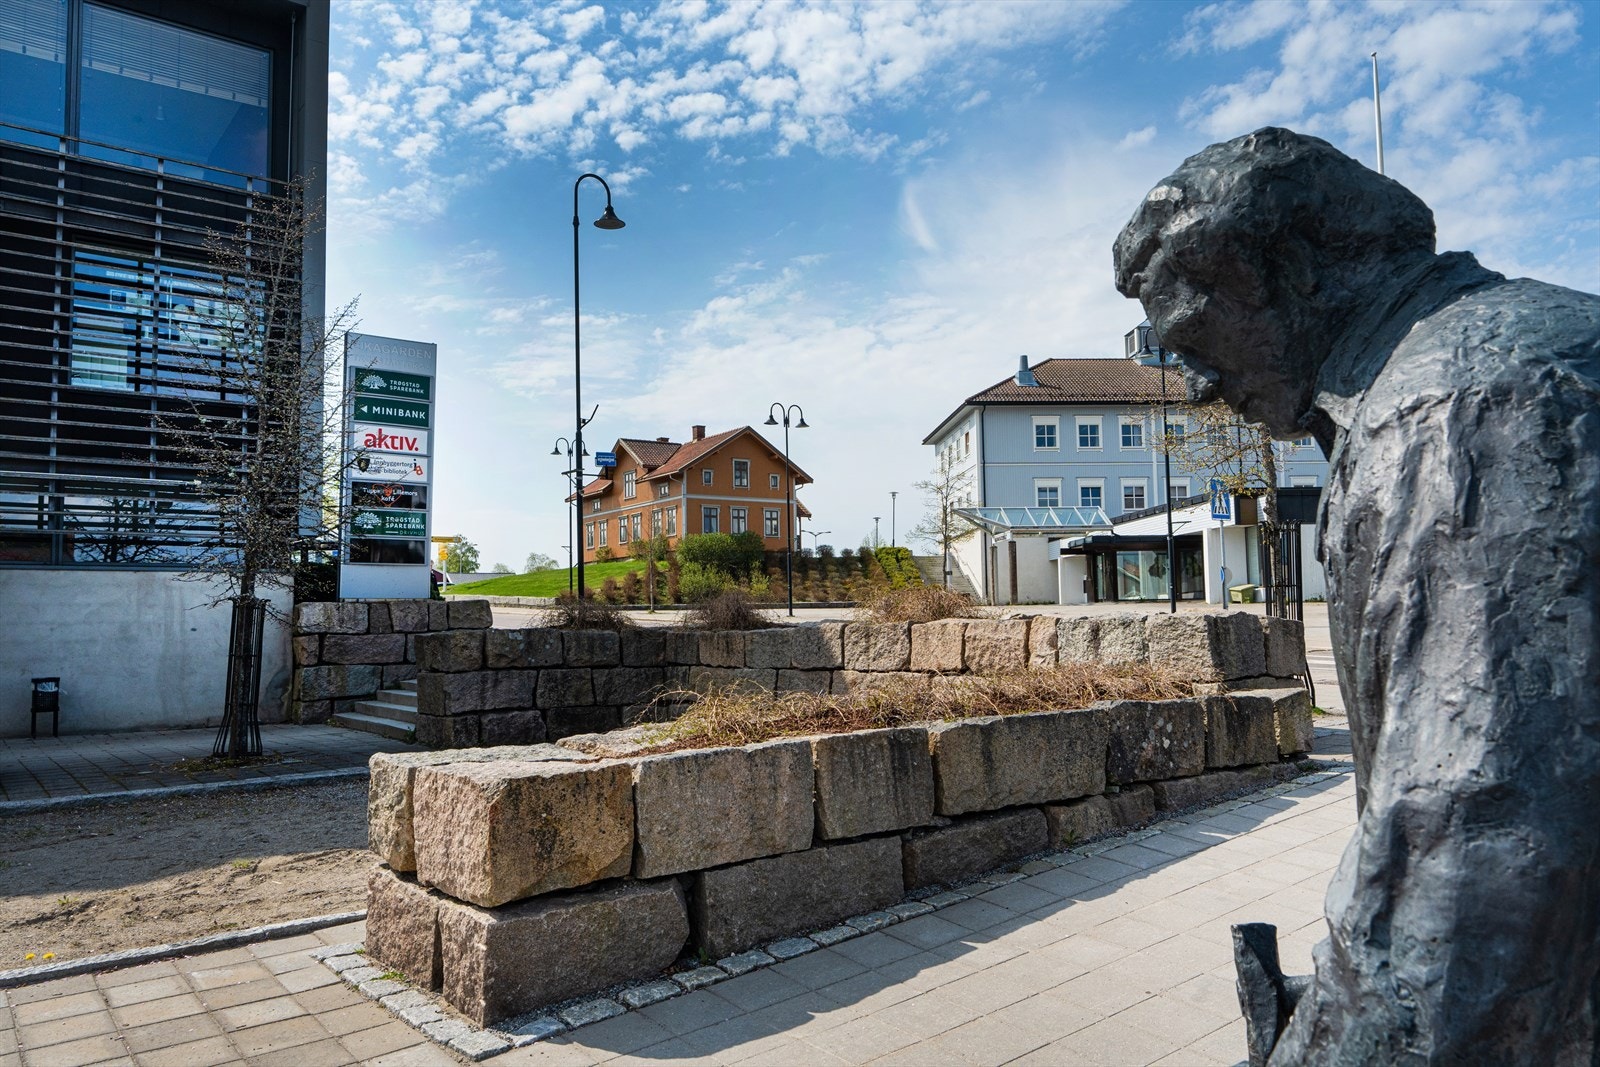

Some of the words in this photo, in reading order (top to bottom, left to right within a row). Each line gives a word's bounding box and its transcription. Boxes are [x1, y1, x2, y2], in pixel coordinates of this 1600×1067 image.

[390, 380, 420, 388] TRØGSTAD
[390, 386, 424, 394] SPAREBANK
[372, 406, 425, 419] MINIBANK
